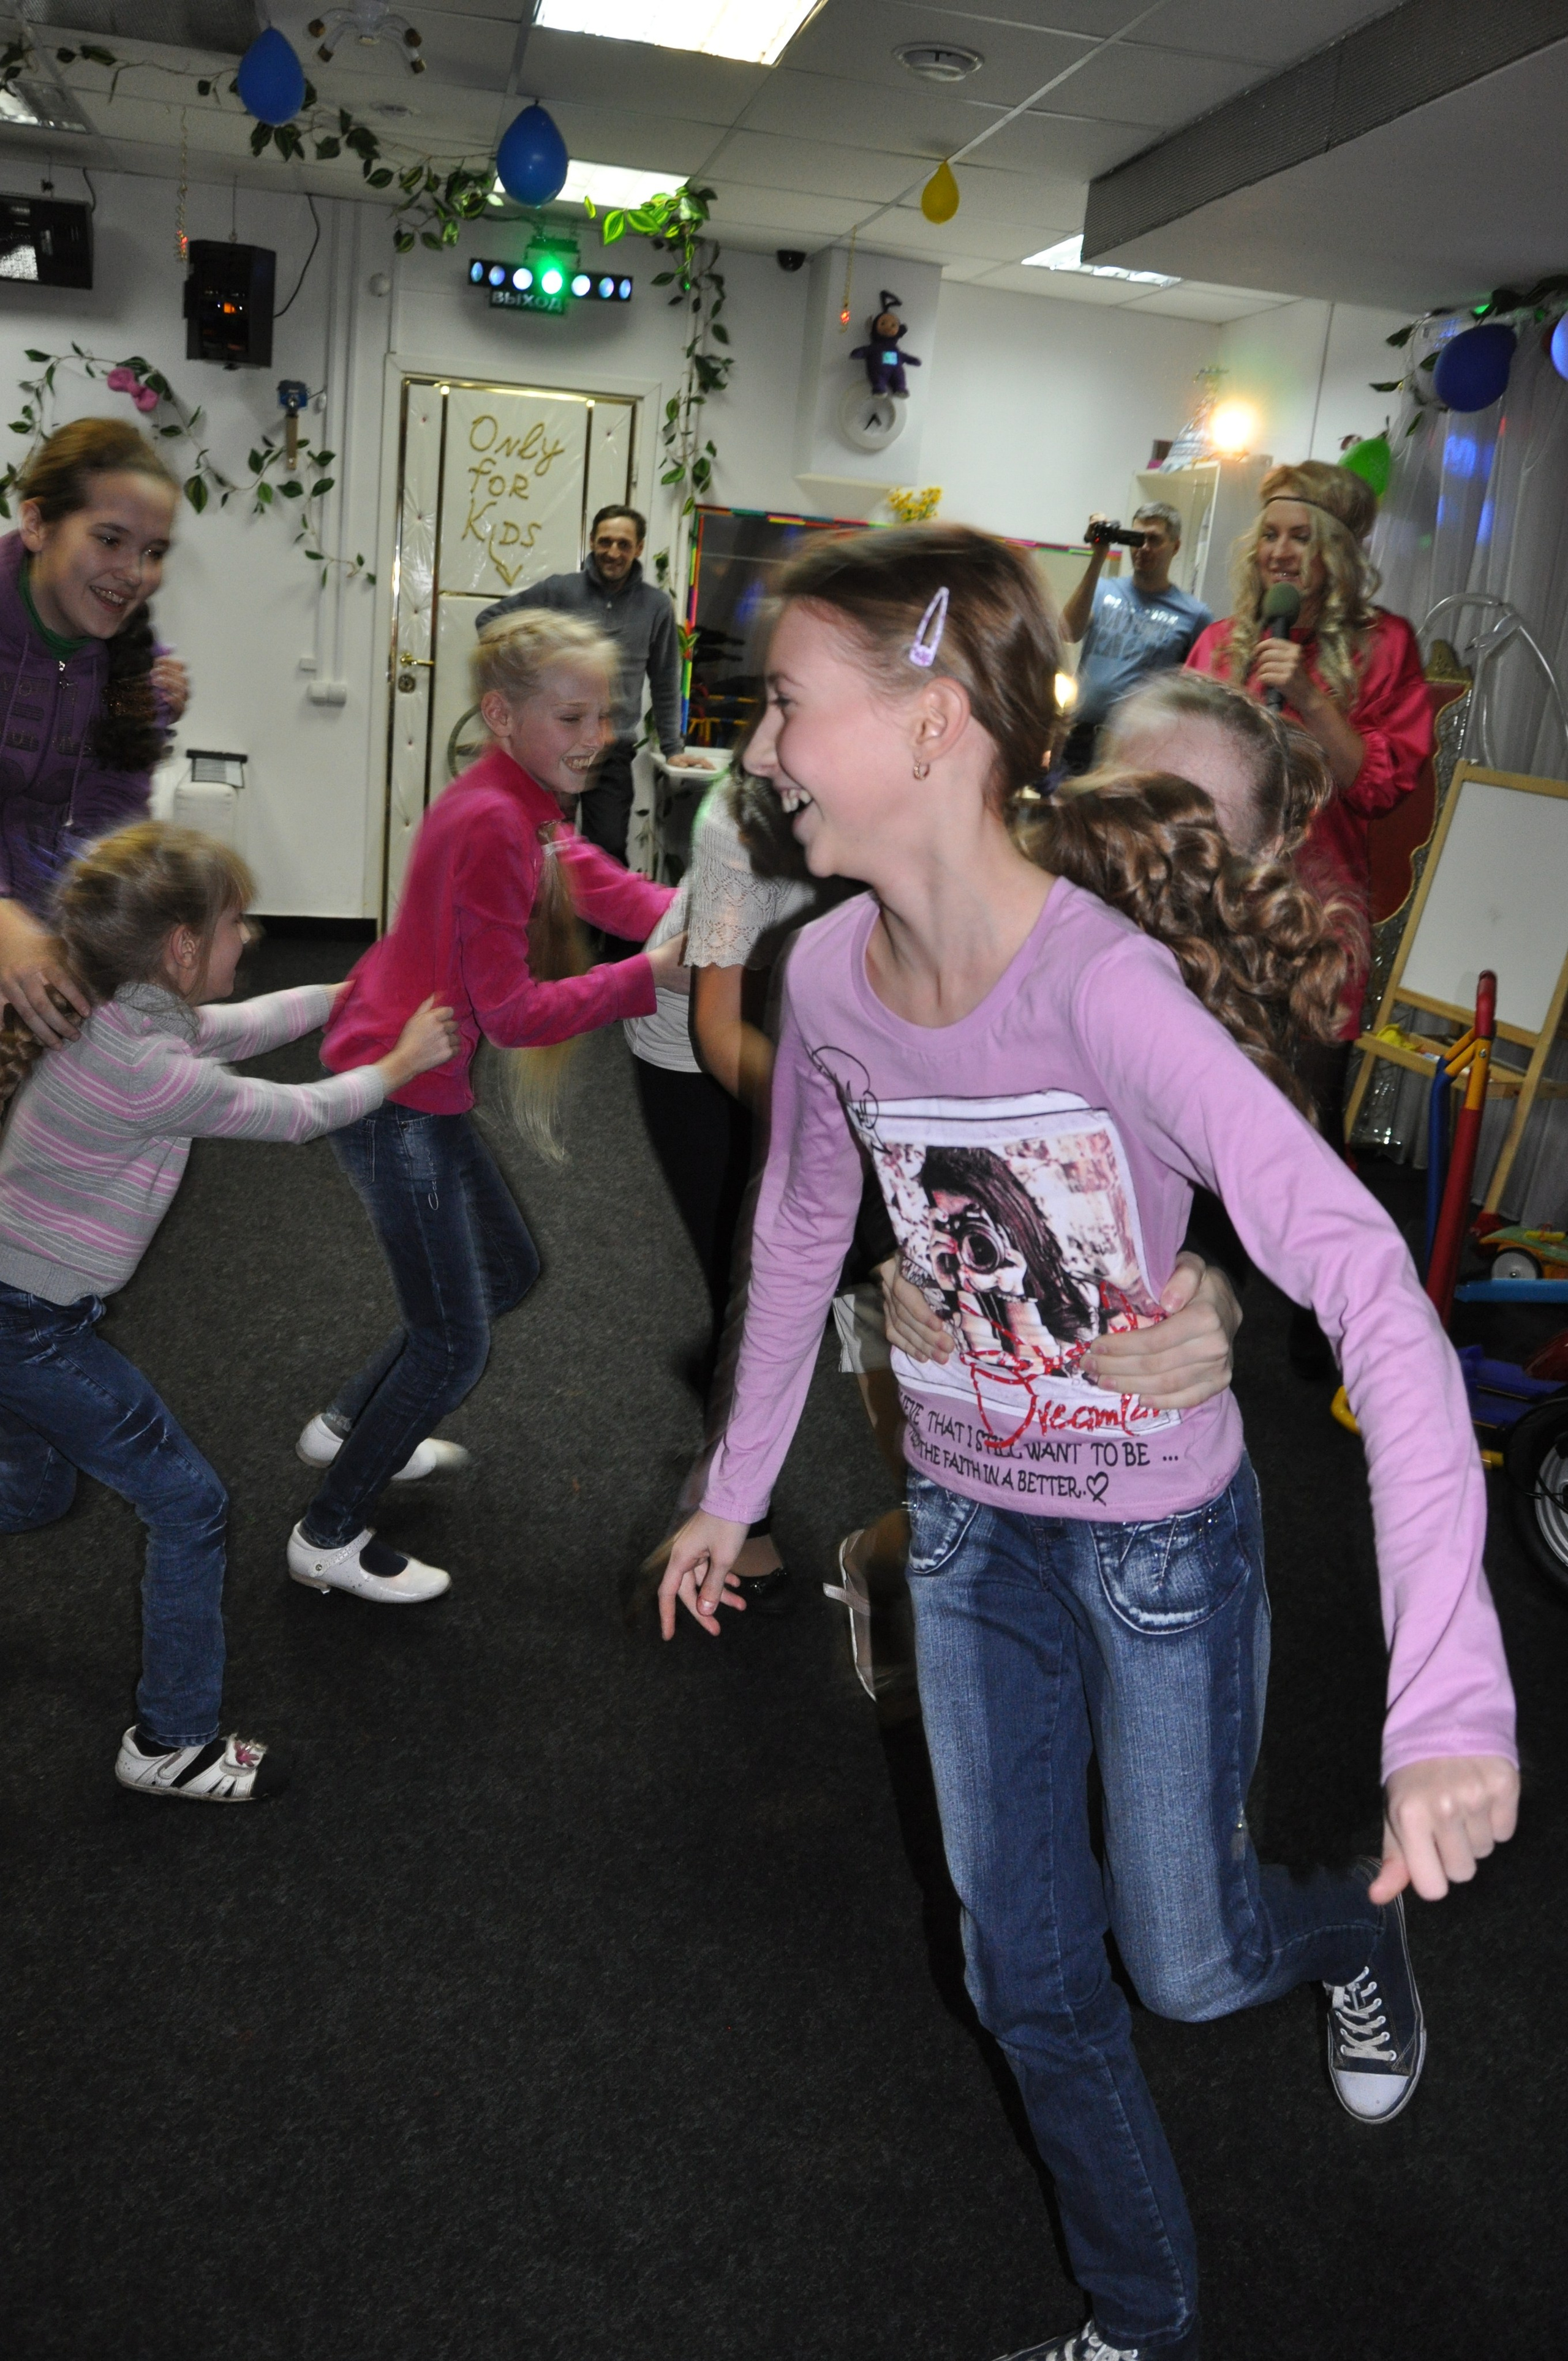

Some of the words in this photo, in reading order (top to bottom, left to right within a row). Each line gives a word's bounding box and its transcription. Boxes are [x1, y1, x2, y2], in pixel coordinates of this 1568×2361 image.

[492, 291, 563, 312] ВЫХОД
[469, 415, 565, 476] Only
[919, 1439, 940, 1464] THE
[943, 1450, 981, 1480] FAITH
[983, 1464, 1000, 1486] IN
[1001, 1468, 1014, 1491] A
[928, 1410, 965, 1443] THAT
[1024, 1441, 1082, 1464] WANT
[1090, 1442, 1118, 1466] TO
